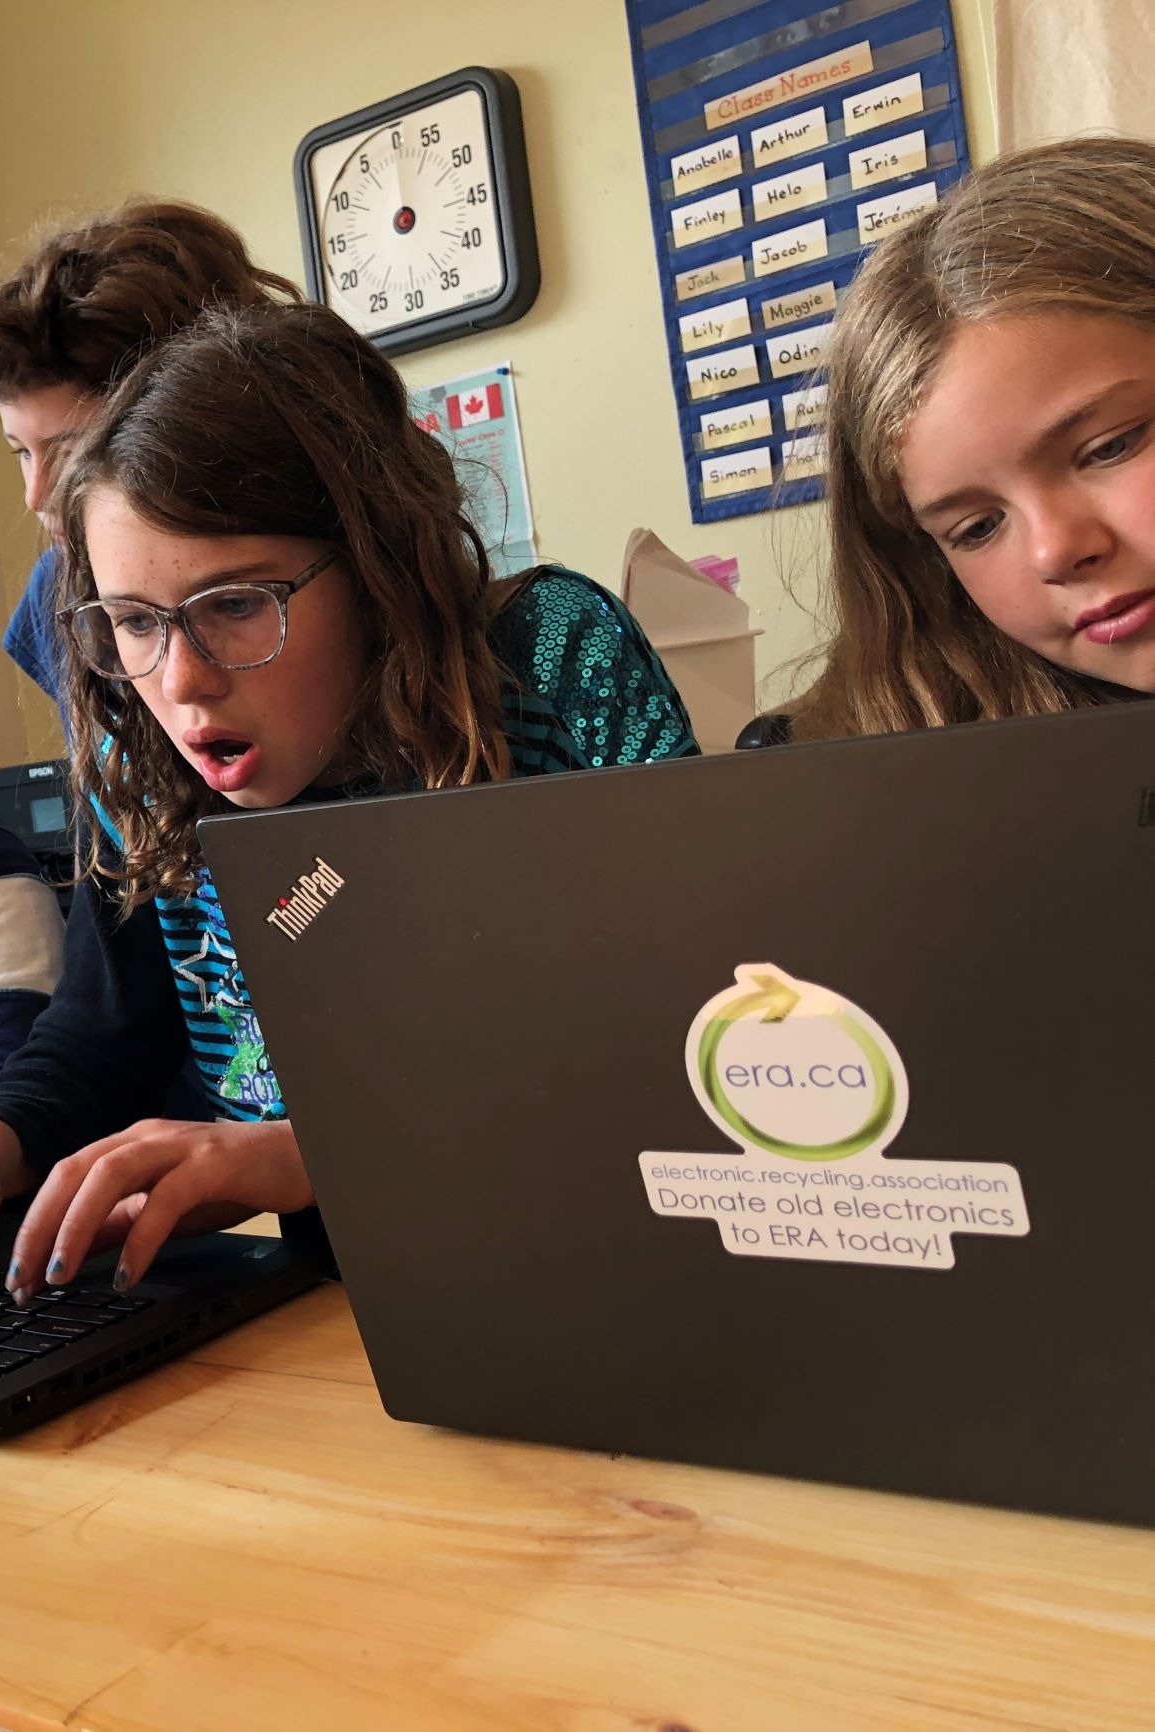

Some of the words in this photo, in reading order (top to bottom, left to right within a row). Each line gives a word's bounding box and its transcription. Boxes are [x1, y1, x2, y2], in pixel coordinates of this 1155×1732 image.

[717, 89, 774, 119] Class
[779, 59, 851, 96] Names
[852, 94, 901, 119] Erwin
[391, 131, 402, 150] 0
[420, 123, 441, 148] 55
[759, 123, 811, 152] Arthur
[359, 154, 370, 173] 5
[452, 144, 472, 169] 50
[677, 148, 734, 179] Anabelle
[862, 154, 899, 175] Iris
[330, 191, 349, 212] 10
[466, 183, 488, 206] 45
[767, 183, 802, 204] Helo
[683, 210, 726, 231] Finley
[327, 233, 346, 255] 15
[460, 227, 482, 250] 40
[760, 240, 808, 265] Jacob
[340, 268, 358, 292] 20
[439, 268, 461, 291] 35
[369, 291, 389, 313] 25
[404, 289, 425, 313] 30
[770, 294, 823, 321] Maggie
[692, 321, 724, 338] Lily
[700, 366, 738, 383] Nico
[707, 414, 755, 437] Pascal
[709, 464, 757, 483] Simon
[265, 856, 346, 941] ThinkPad
[725, 1061, 868, 1089] era.ca
[650, 1163, 1009, 1195] electronic.recycling.association
[658, 1187, 767, 1215] Donate
[776, 1193, 824, 1217] old
[833, 1196, 1015, 1228] electronics
[730, 1222, 760, 1244] to
[769, 1225, 828, 1249] ERA
[836, 1227, 942, 1261] today!
